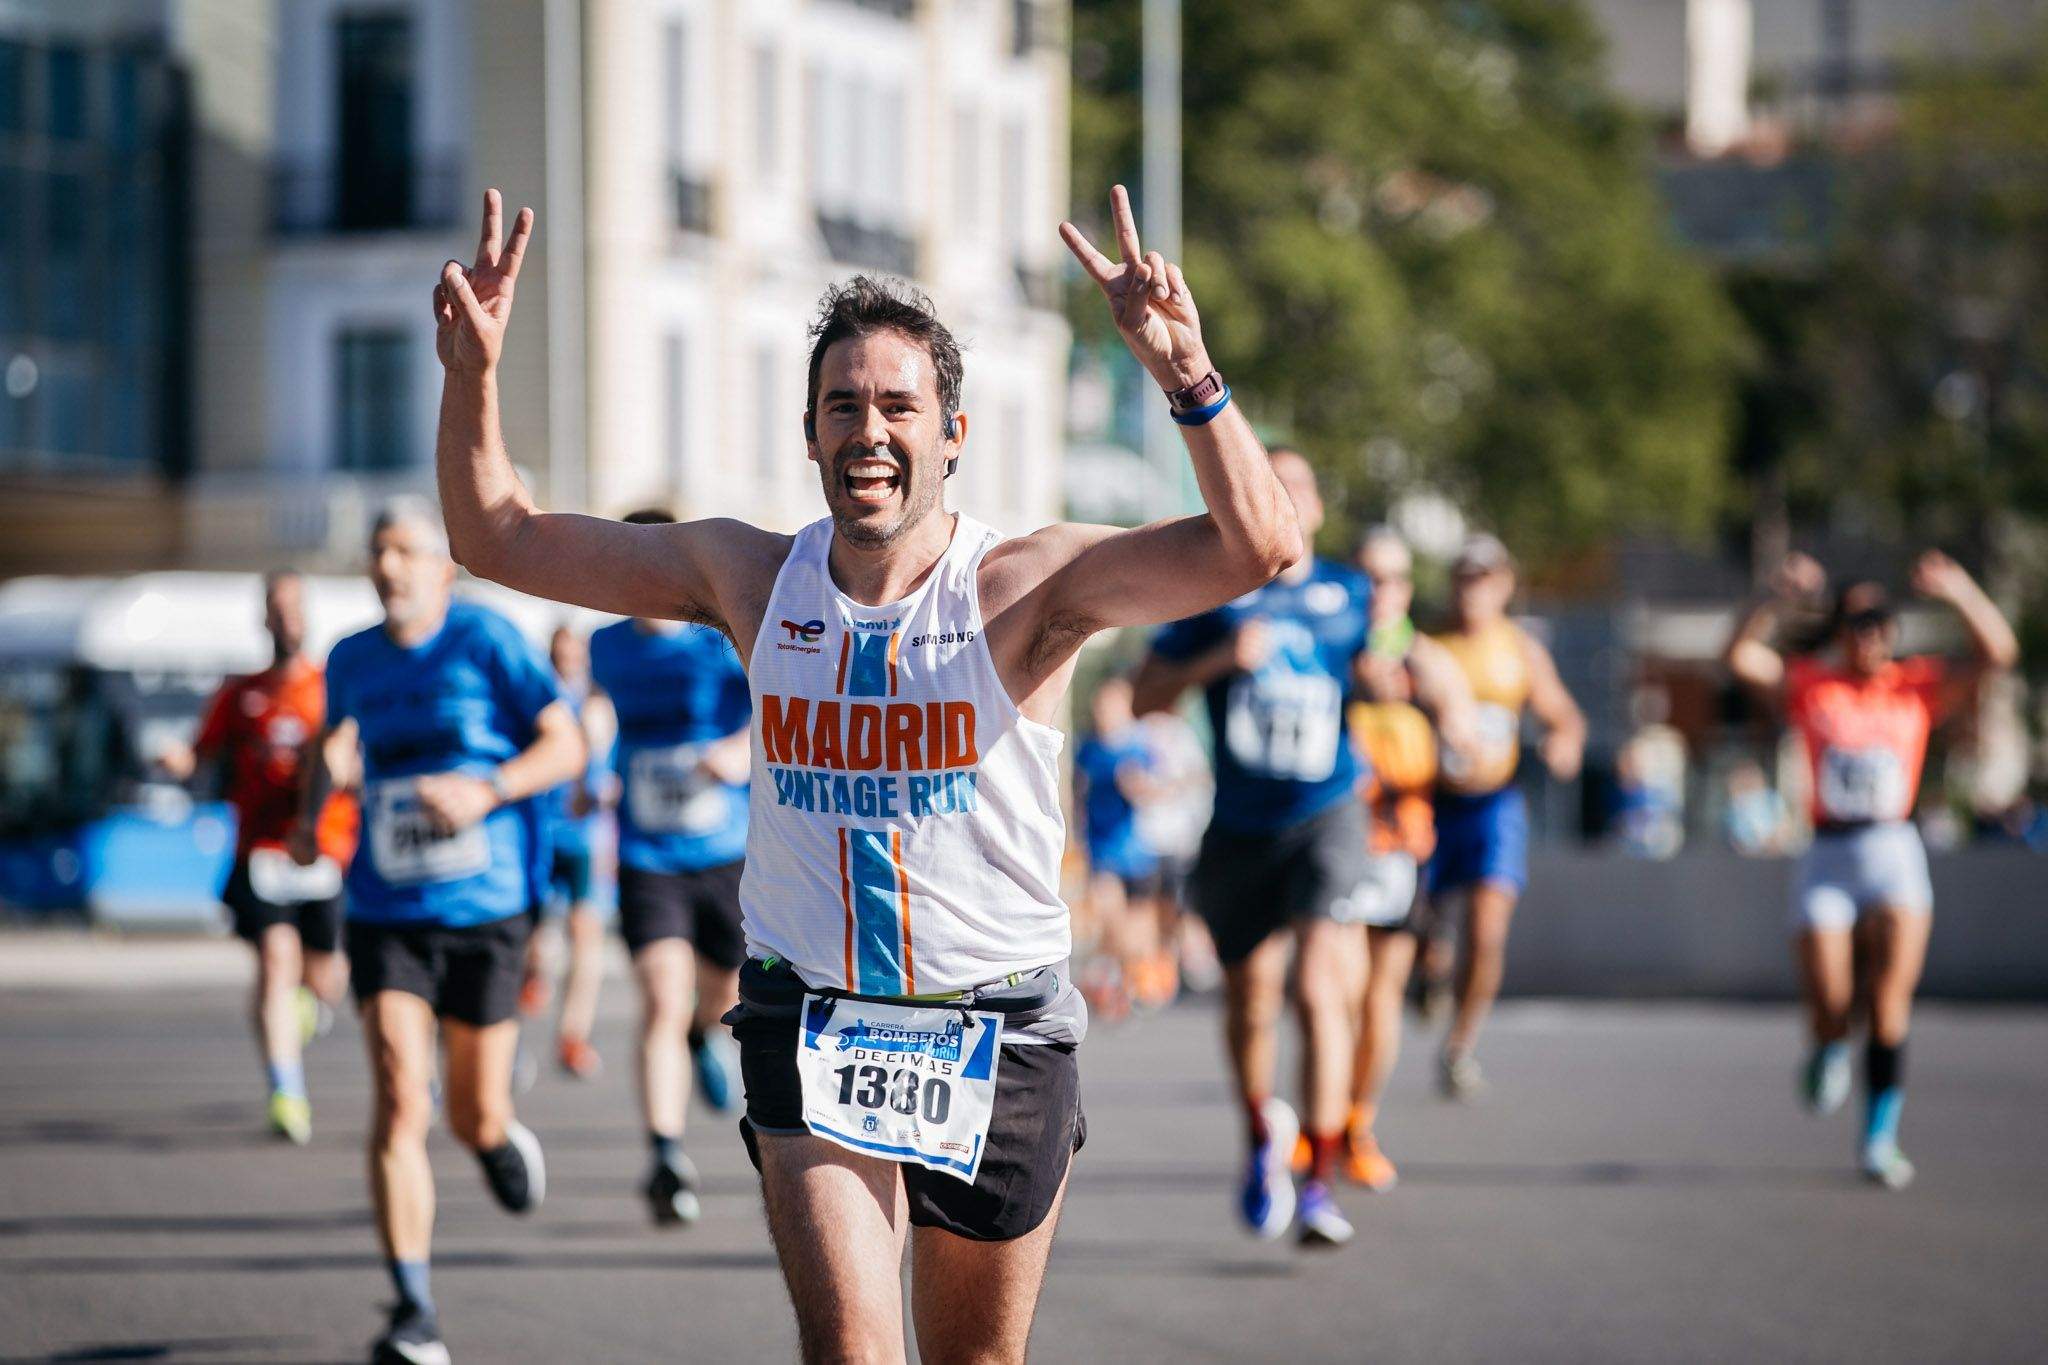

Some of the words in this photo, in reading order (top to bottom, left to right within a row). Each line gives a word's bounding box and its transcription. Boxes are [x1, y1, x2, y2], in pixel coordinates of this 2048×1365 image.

[912, 631, 974, 647] SAMSUNG
[777, 643, 821, 655] TotalEnergies
[761, 694, 979, 771] MADRID
[768, 768, 899, 818] VINTAGE
[908, 772, 979, 818] RUN
[870, 1021, 905, 1031] CARRERA
[919, 1042, 958, 1060] MDRID
[855, 1049, 953, 1075] DECIMAS
